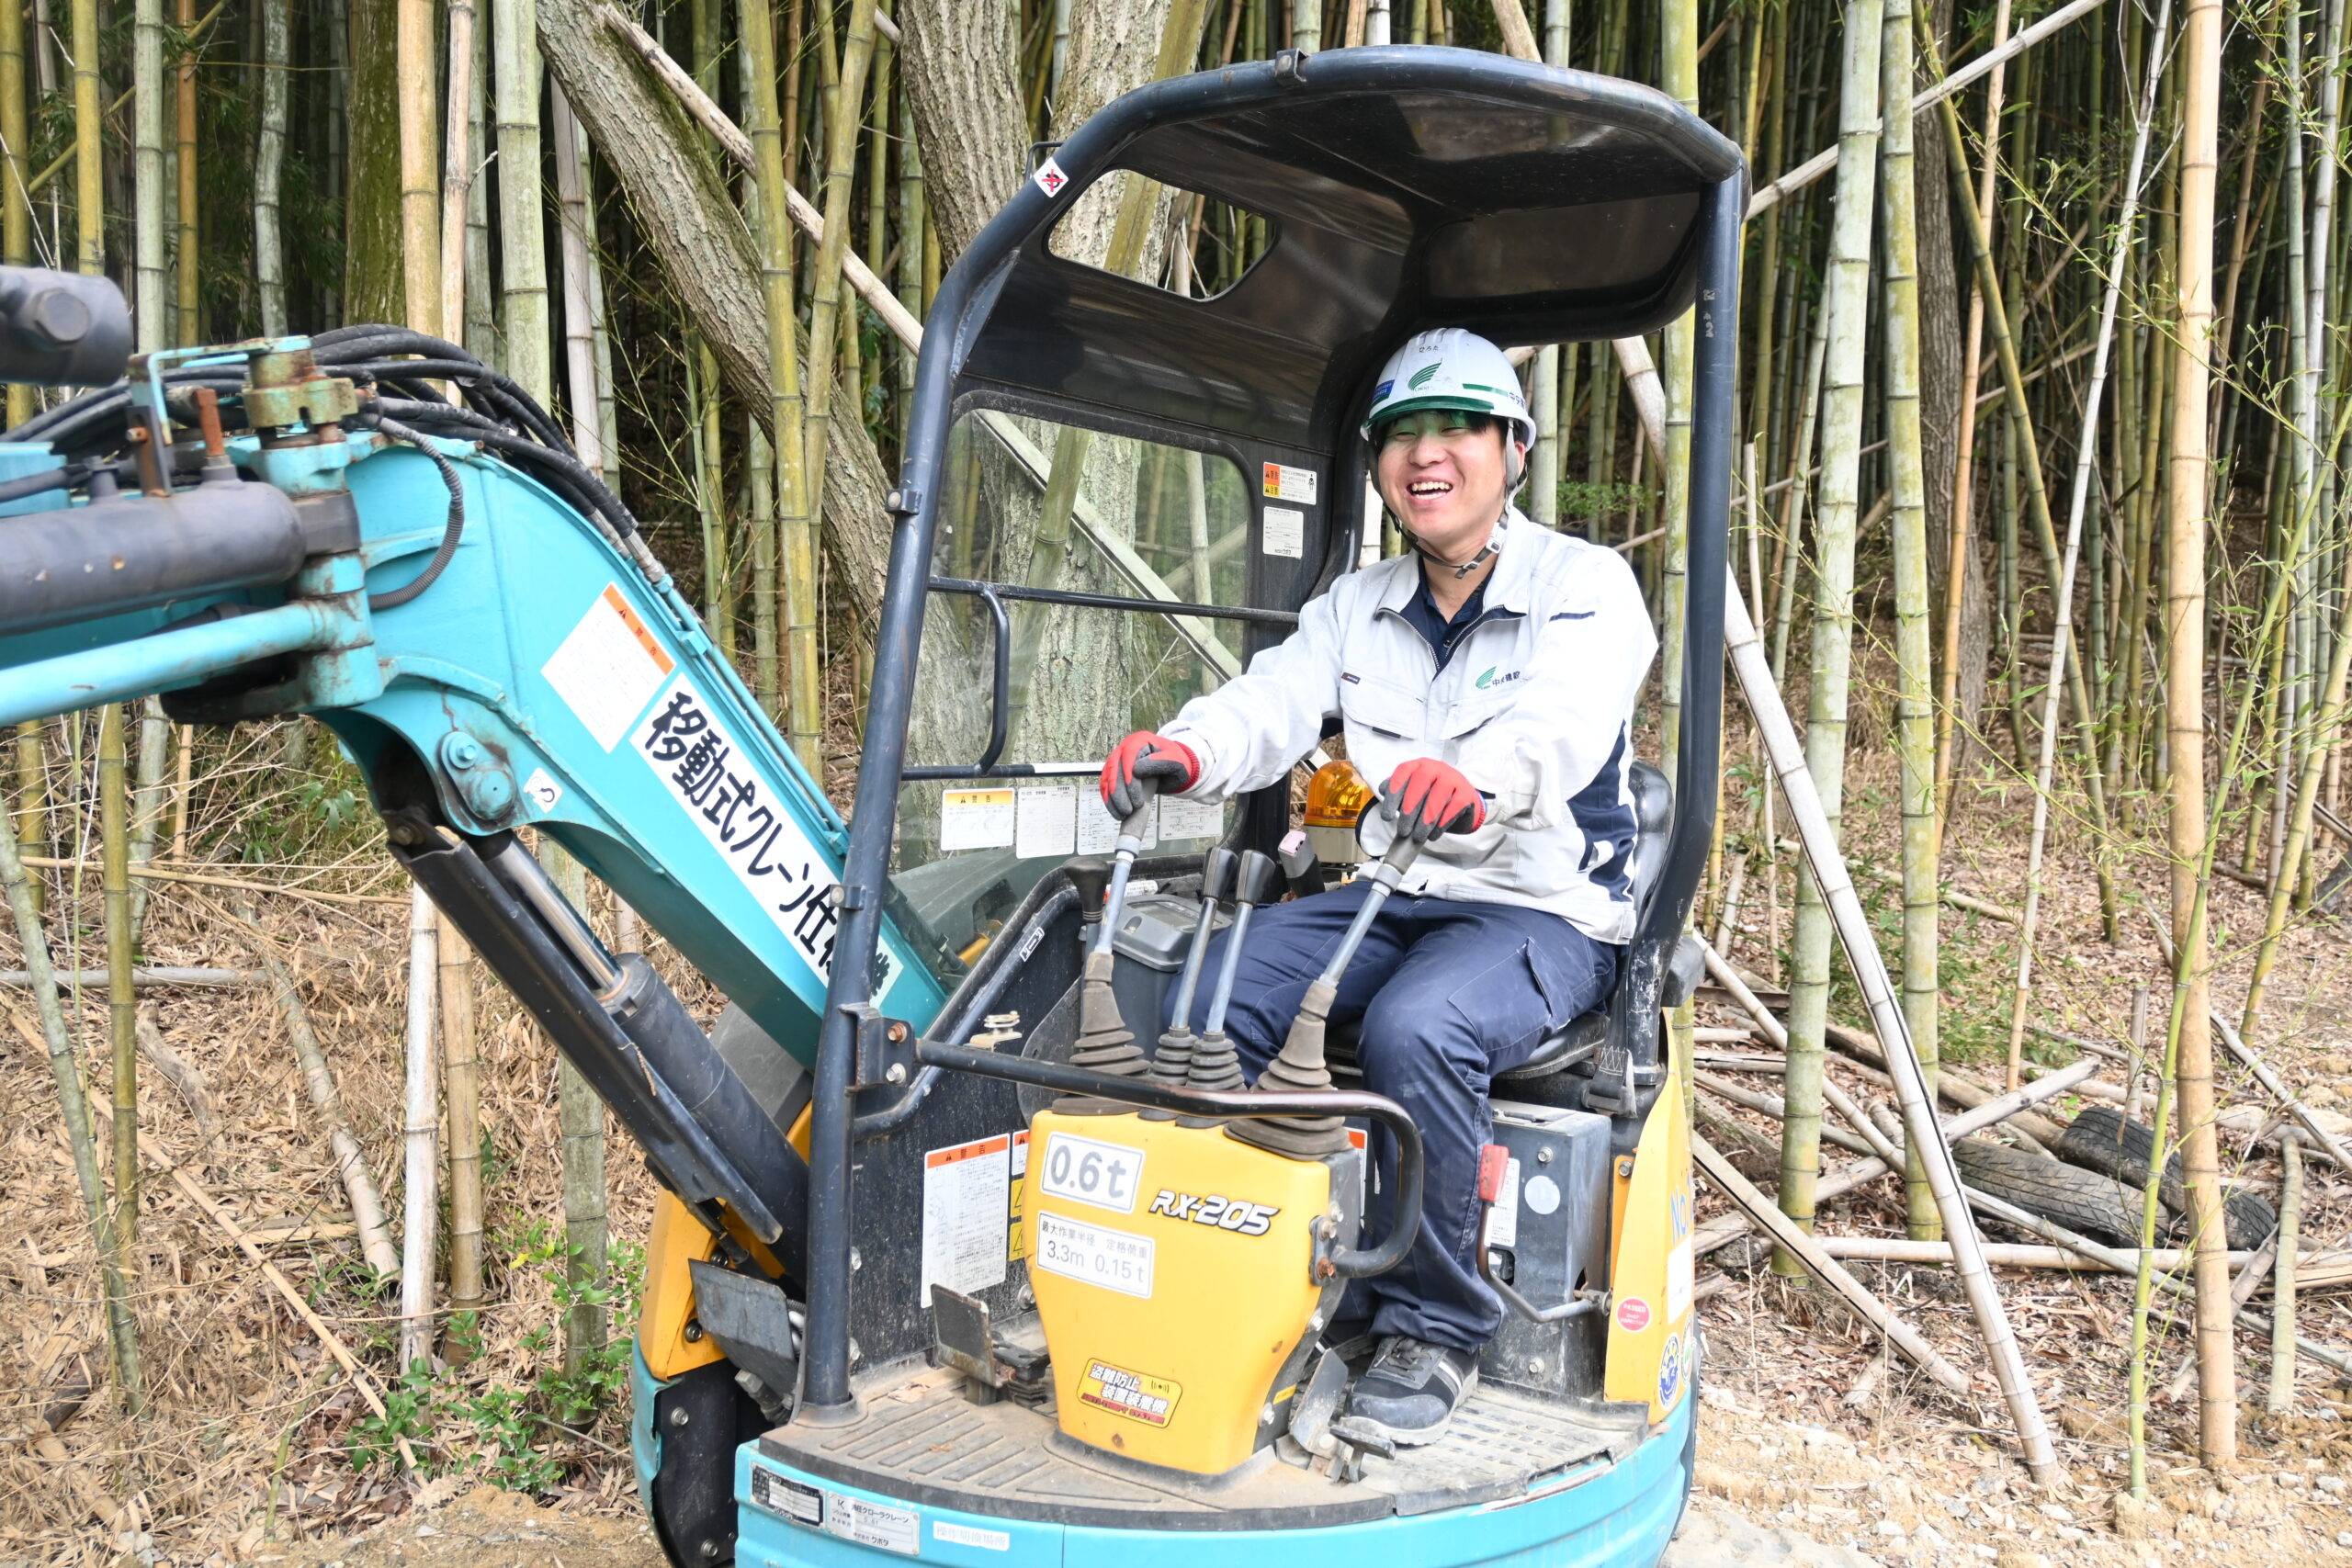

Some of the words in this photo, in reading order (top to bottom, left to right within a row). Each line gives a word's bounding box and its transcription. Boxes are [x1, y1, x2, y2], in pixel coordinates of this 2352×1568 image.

[1148, 1189, 1281, 1236] RX-205
[1041, 1220, 1095, 1247] 最大作業半径
[1106, 1237, 1148, 1259] 定格荷重
[1089, 1362, 1140, 1393] 盗難防止
